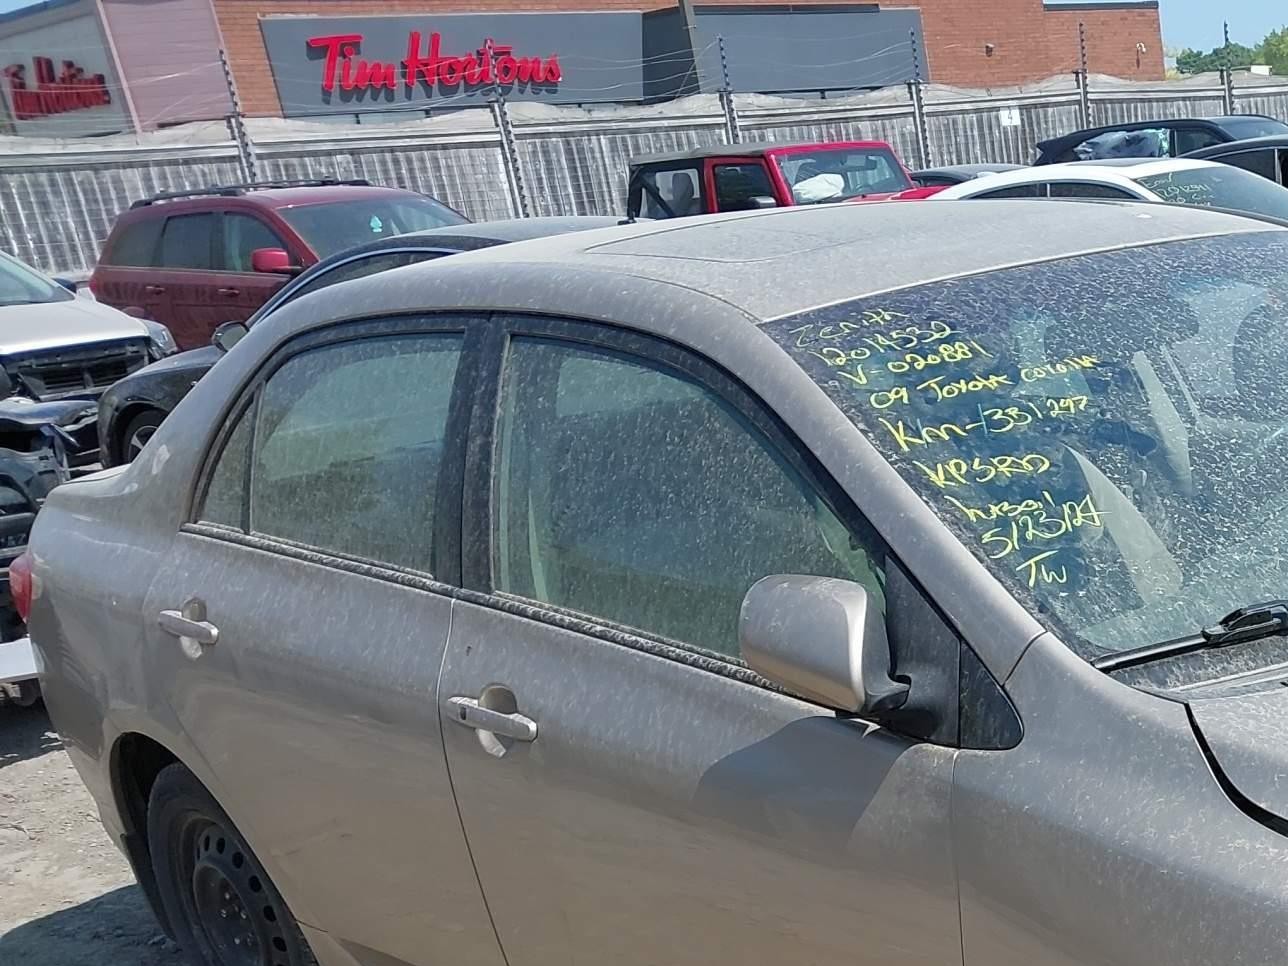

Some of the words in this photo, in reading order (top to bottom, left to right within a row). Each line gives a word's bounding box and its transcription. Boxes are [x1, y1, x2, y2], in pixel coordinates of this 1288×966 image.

[306, 34, 398, 91] Tim
[403, 31, 562, 87] Hortons
[808, 321, 963, 367] 12014532
[870, 387, 909, 410] 09
[982, 494, 1112, 559] 5/23/24
